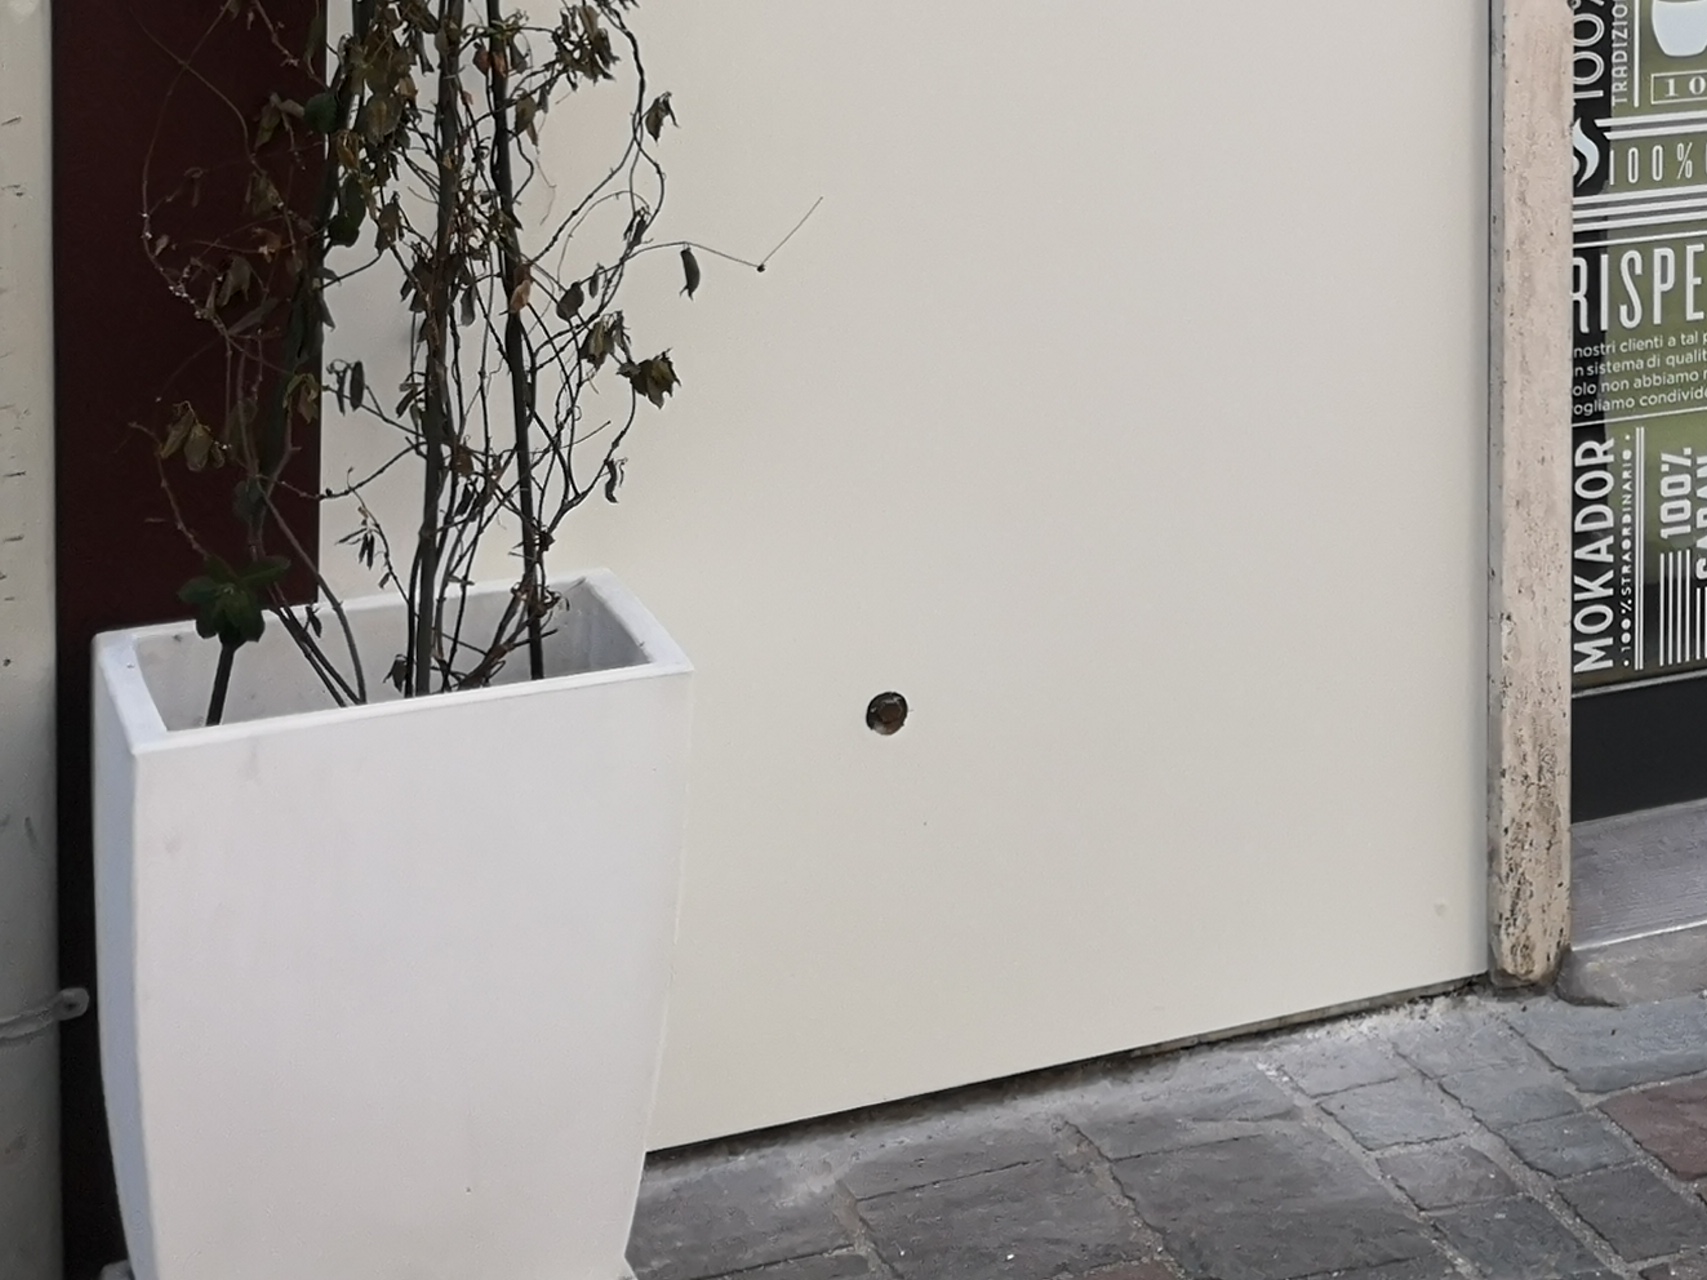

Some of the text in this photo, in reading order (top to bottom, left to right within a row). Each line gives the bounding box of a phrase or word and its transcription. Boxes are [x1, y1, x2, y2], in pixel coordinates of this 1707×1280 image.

[1573, 340, 1616, 358] nostri
[1619, 335, 1663, 353] clienti
[1681, 332, 1698, 345] tal
[1587, 358, 1644, 376] sistema
[1600, 377, 1630, 393] non
[1633, 369, 1699, 388] abbiamo
[1620, 448, 1632, 596] STRAORDINARIO
[1660, 446, 1692, 540] 100%
[1573, 438, 1615, 673] MOKADOR
